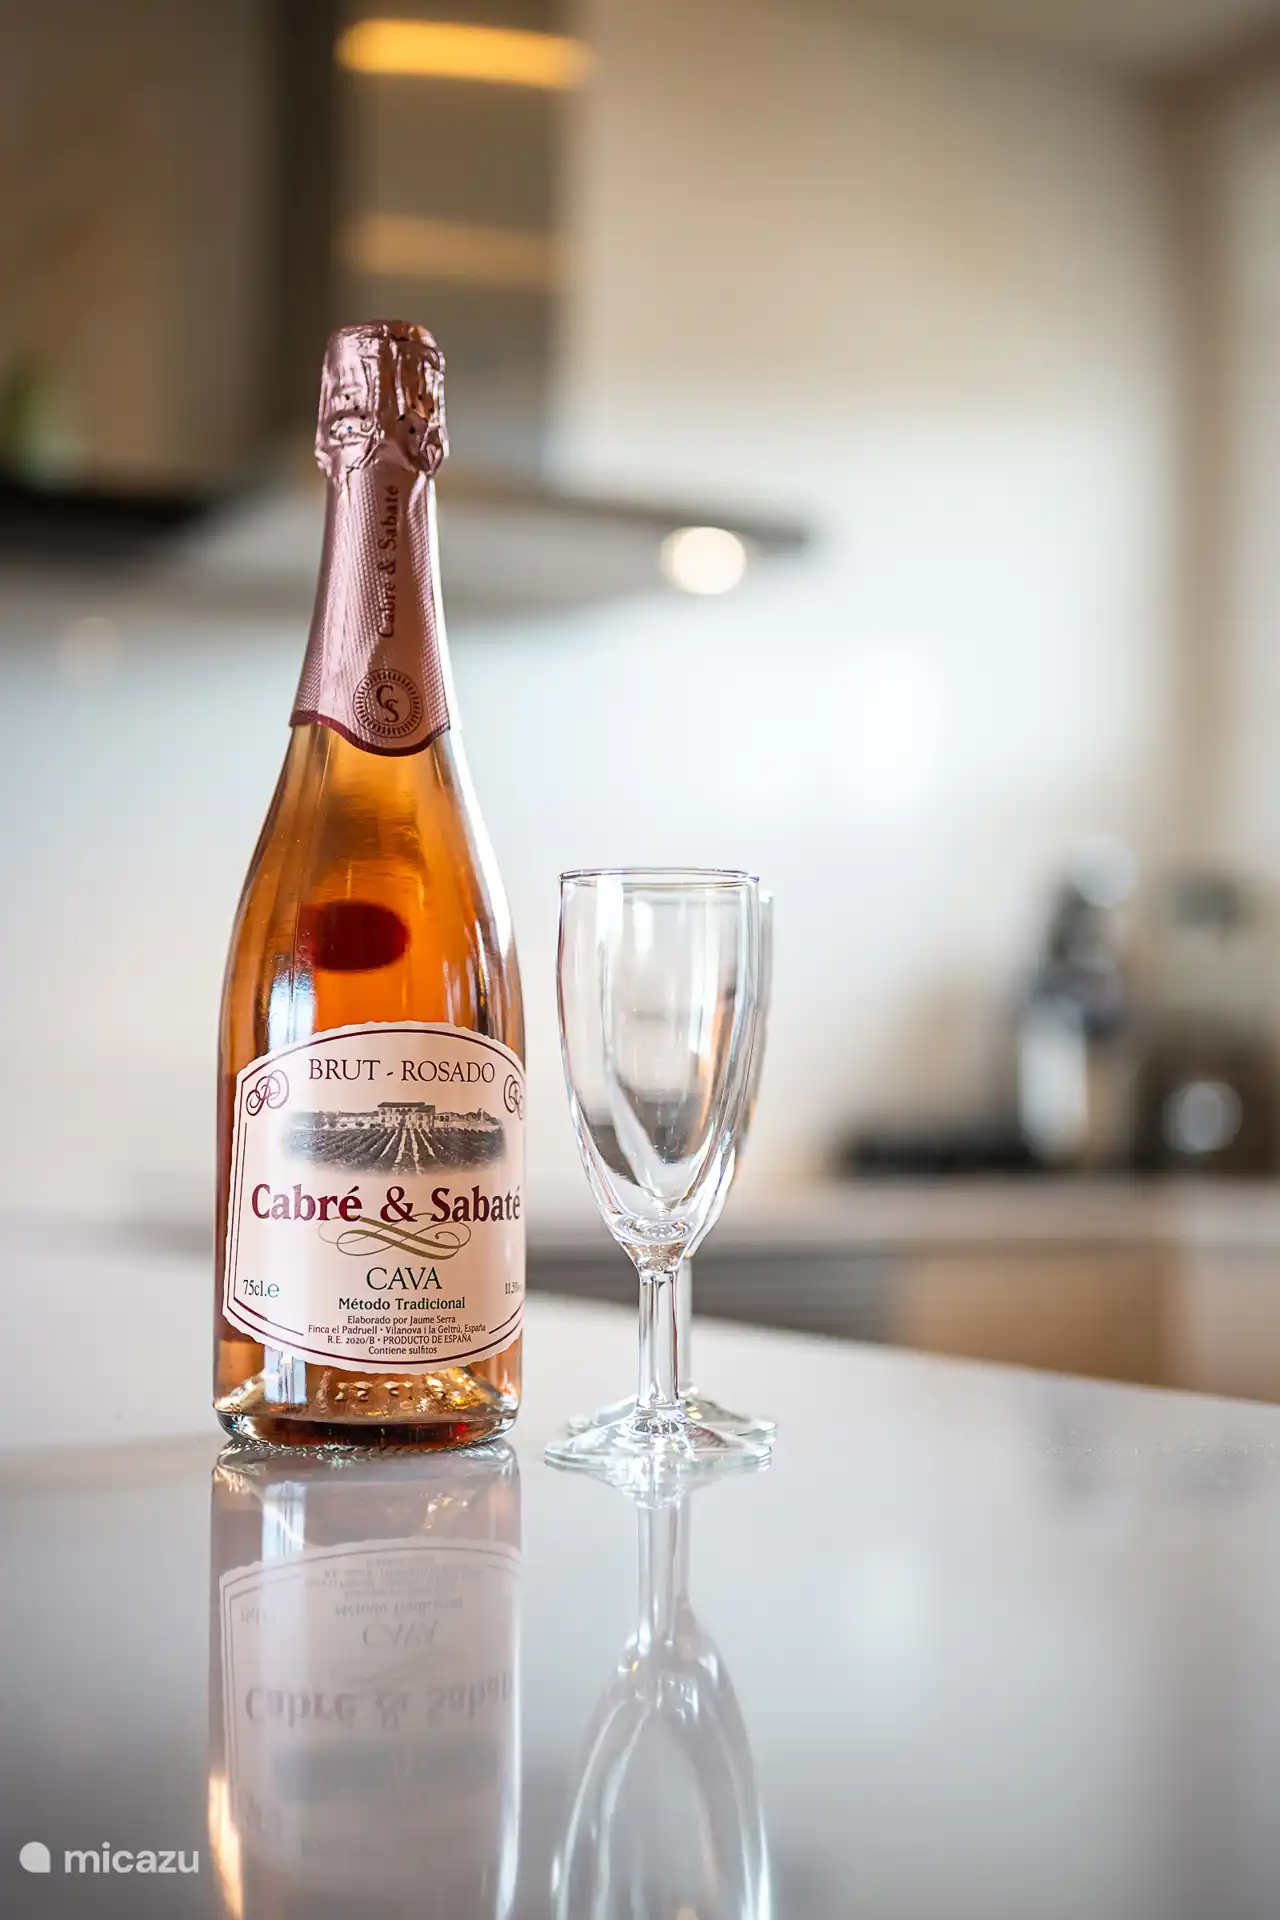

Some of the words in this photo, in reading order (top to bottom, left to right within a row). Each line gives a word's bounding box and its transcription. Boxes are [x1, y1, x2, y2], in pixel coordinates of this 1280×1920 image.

[378, 558, 396, 575] &
[309, 1059, 381, 1081] BRUT
[400, 1060, 496, 1083] ROSADO
[251, 1184, 363, 1222] Cabré
[380, 1186, 417, 1222] &
[430, 1185, 521, 1223] Sabaté
[366, 1267, 443, 1291] CAVA
[338, 1297, 391, 1311] Método
[395, 1296, 466, 1310] Tradicional
[347, 1315, 391, 1325] Elaborado
[393, 1317, 408, 1326] por
[409, 1315, 435, 1327] Jaume
[436, 1315, 456, 1324] Serra
[308, 1324, 330, 1334] Finca
[331, 1325, 340, 1334] el
[341, 1325, 378, 1335] Padruell
[385, 1325, 422, 1335] Vilanova
[428, 1325, 436, 1334] la
[464, 1323, 486, 1334] España
[345, 1335, 375, 1345] 2020/B
[383, 1335, 430, 1345] PRODUCTO
[431, 1335, 443, 1344] DE
[444, 1332, 472, 1343] ESPAÑA
[368, 1346, 407, 1355] Contiene
[408, 1345, 438, 1355] sulfitos
